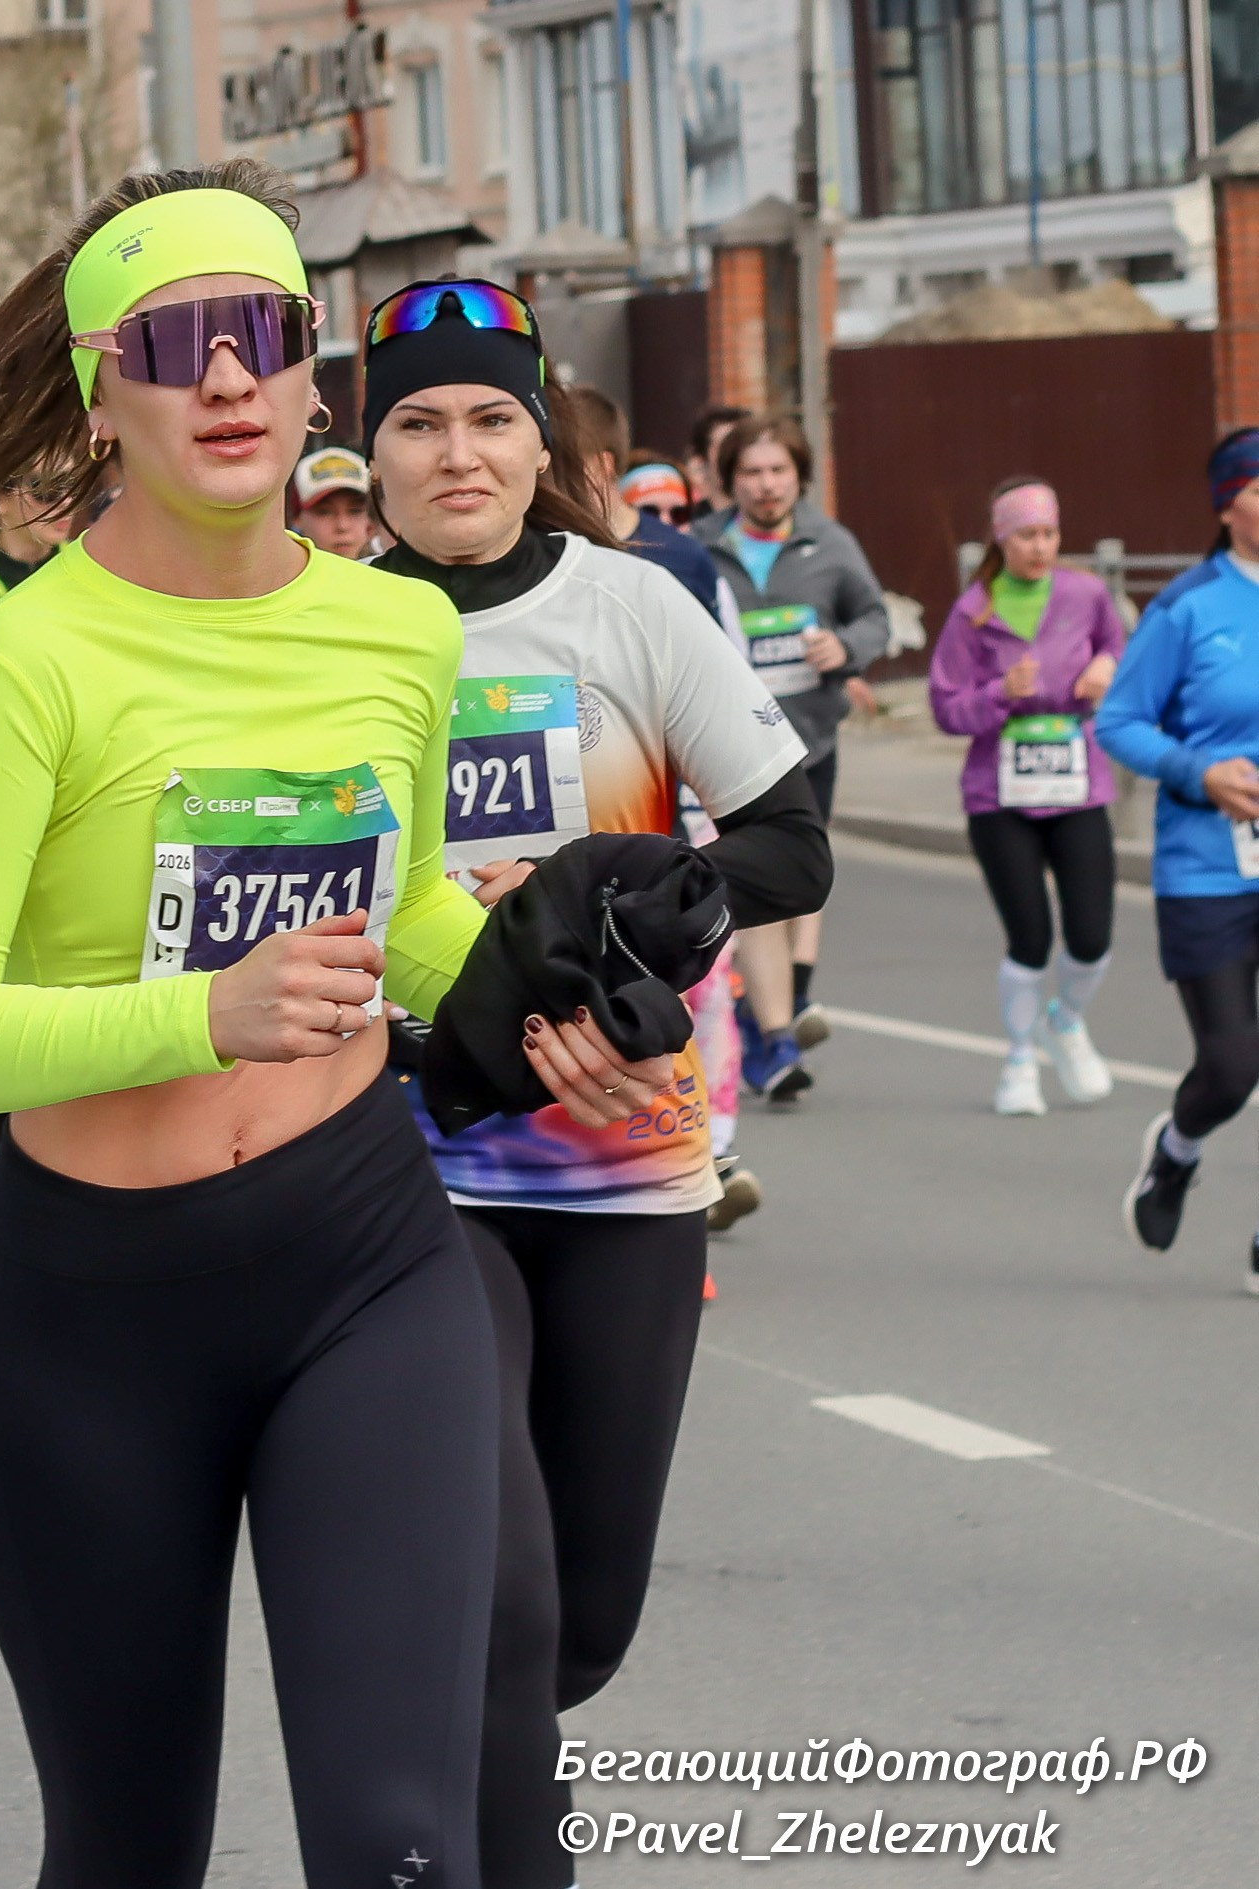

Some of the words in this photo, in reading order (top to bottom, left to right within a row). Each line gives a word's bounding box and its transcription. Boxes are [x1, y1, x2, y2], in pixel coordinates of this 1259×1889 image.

[207, 799, 253, 813] СБЕР
[157, 853, 191, 870] 2026
[158, 892, 183, 931] D
[207, 866, 363, 942] 37561
